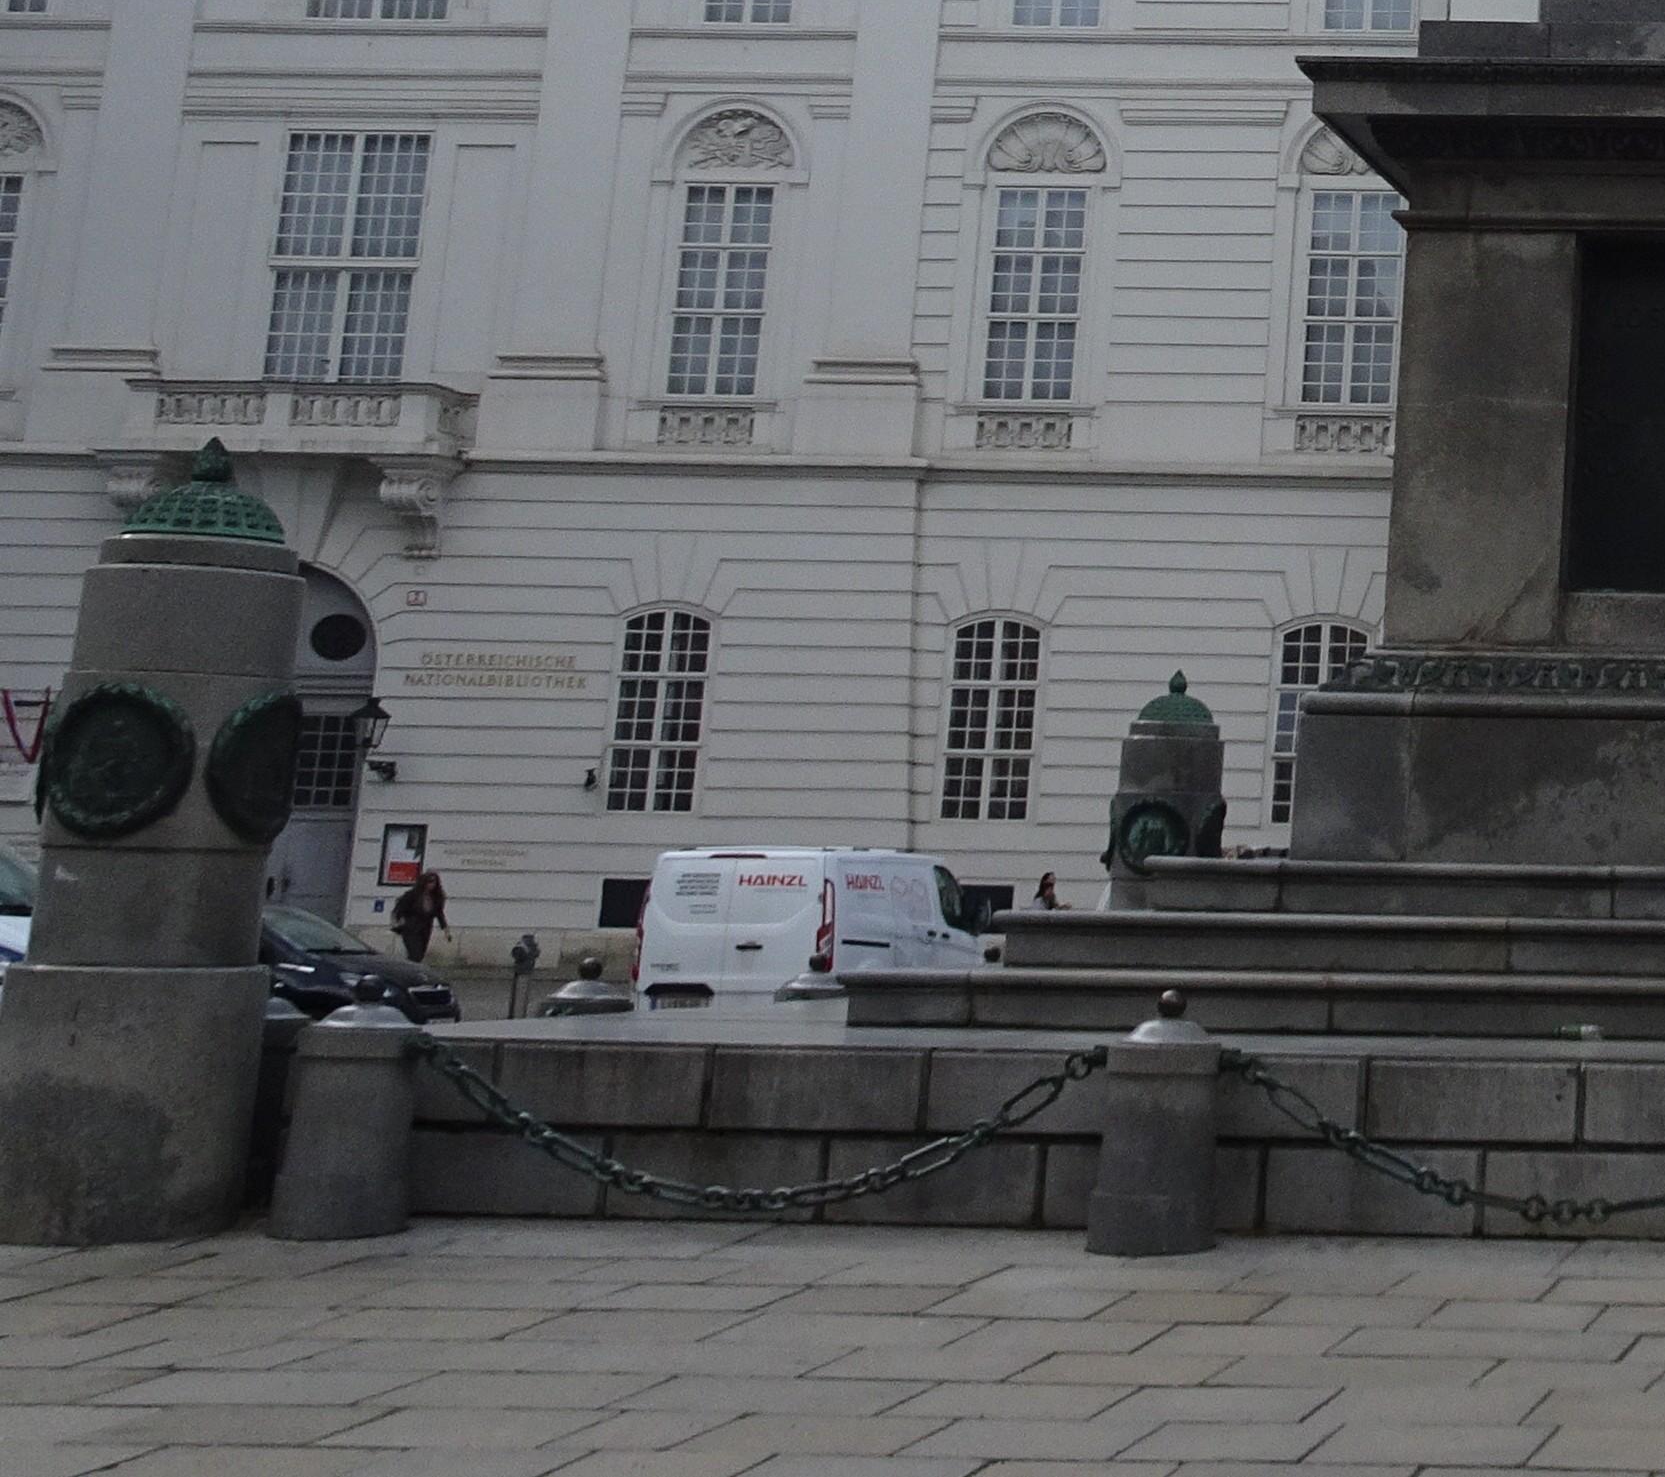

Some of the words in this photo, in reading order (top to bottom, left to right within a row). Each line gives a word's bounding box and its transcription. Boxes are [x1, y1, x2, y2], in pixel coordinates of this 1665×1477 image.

[422, 650, 577, 669] ÖSTERREICHISCHE
[403, 673, 587, 689] NATIONALBIBLIOTHEK
[738, 875, 808, 887] HAINZL
